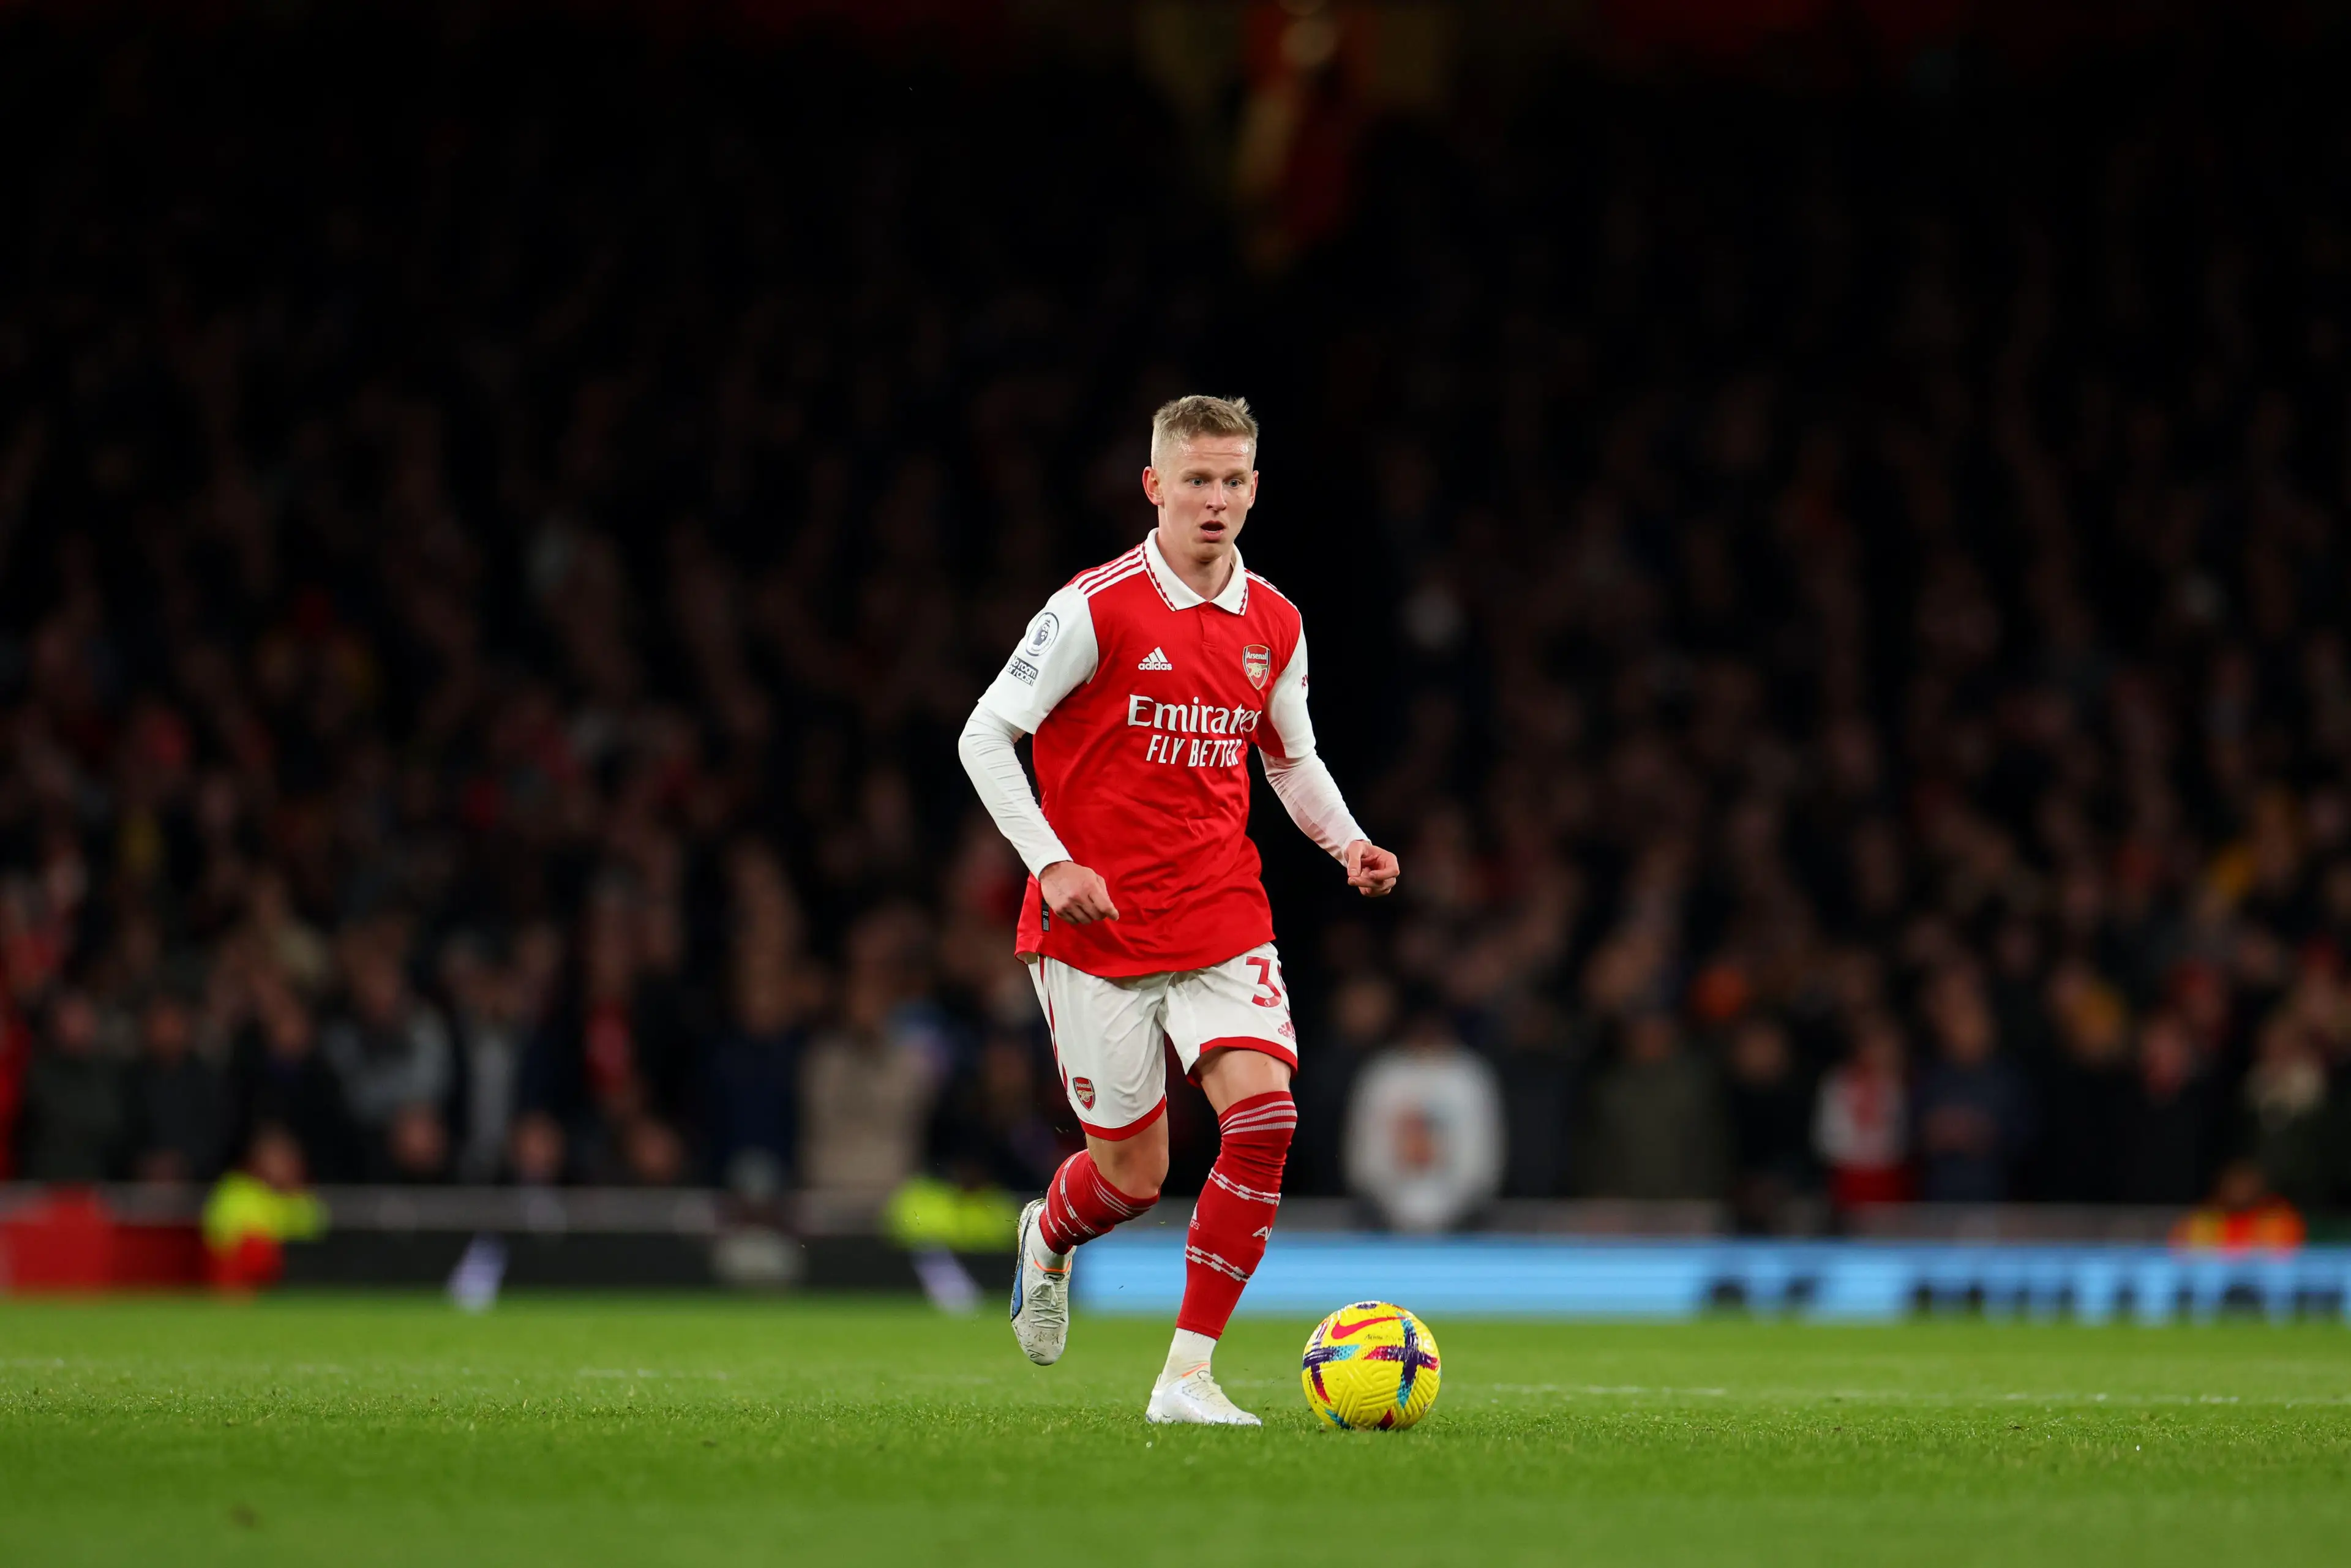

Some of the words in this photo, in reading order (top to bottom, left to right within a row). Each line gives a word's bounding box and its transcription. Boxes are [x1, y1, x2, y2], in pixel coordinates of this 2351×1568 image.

[1247, 651, 1267, 660] Arsenal
[1018, 662, 1037, 678] room
[1138, 661, 1172, 671] adidas
[1128, 694, 1262, 734] Emirates
[1146, 735, 1185, 764] FLY
[1188, 738, 1242, 768] BETTER
